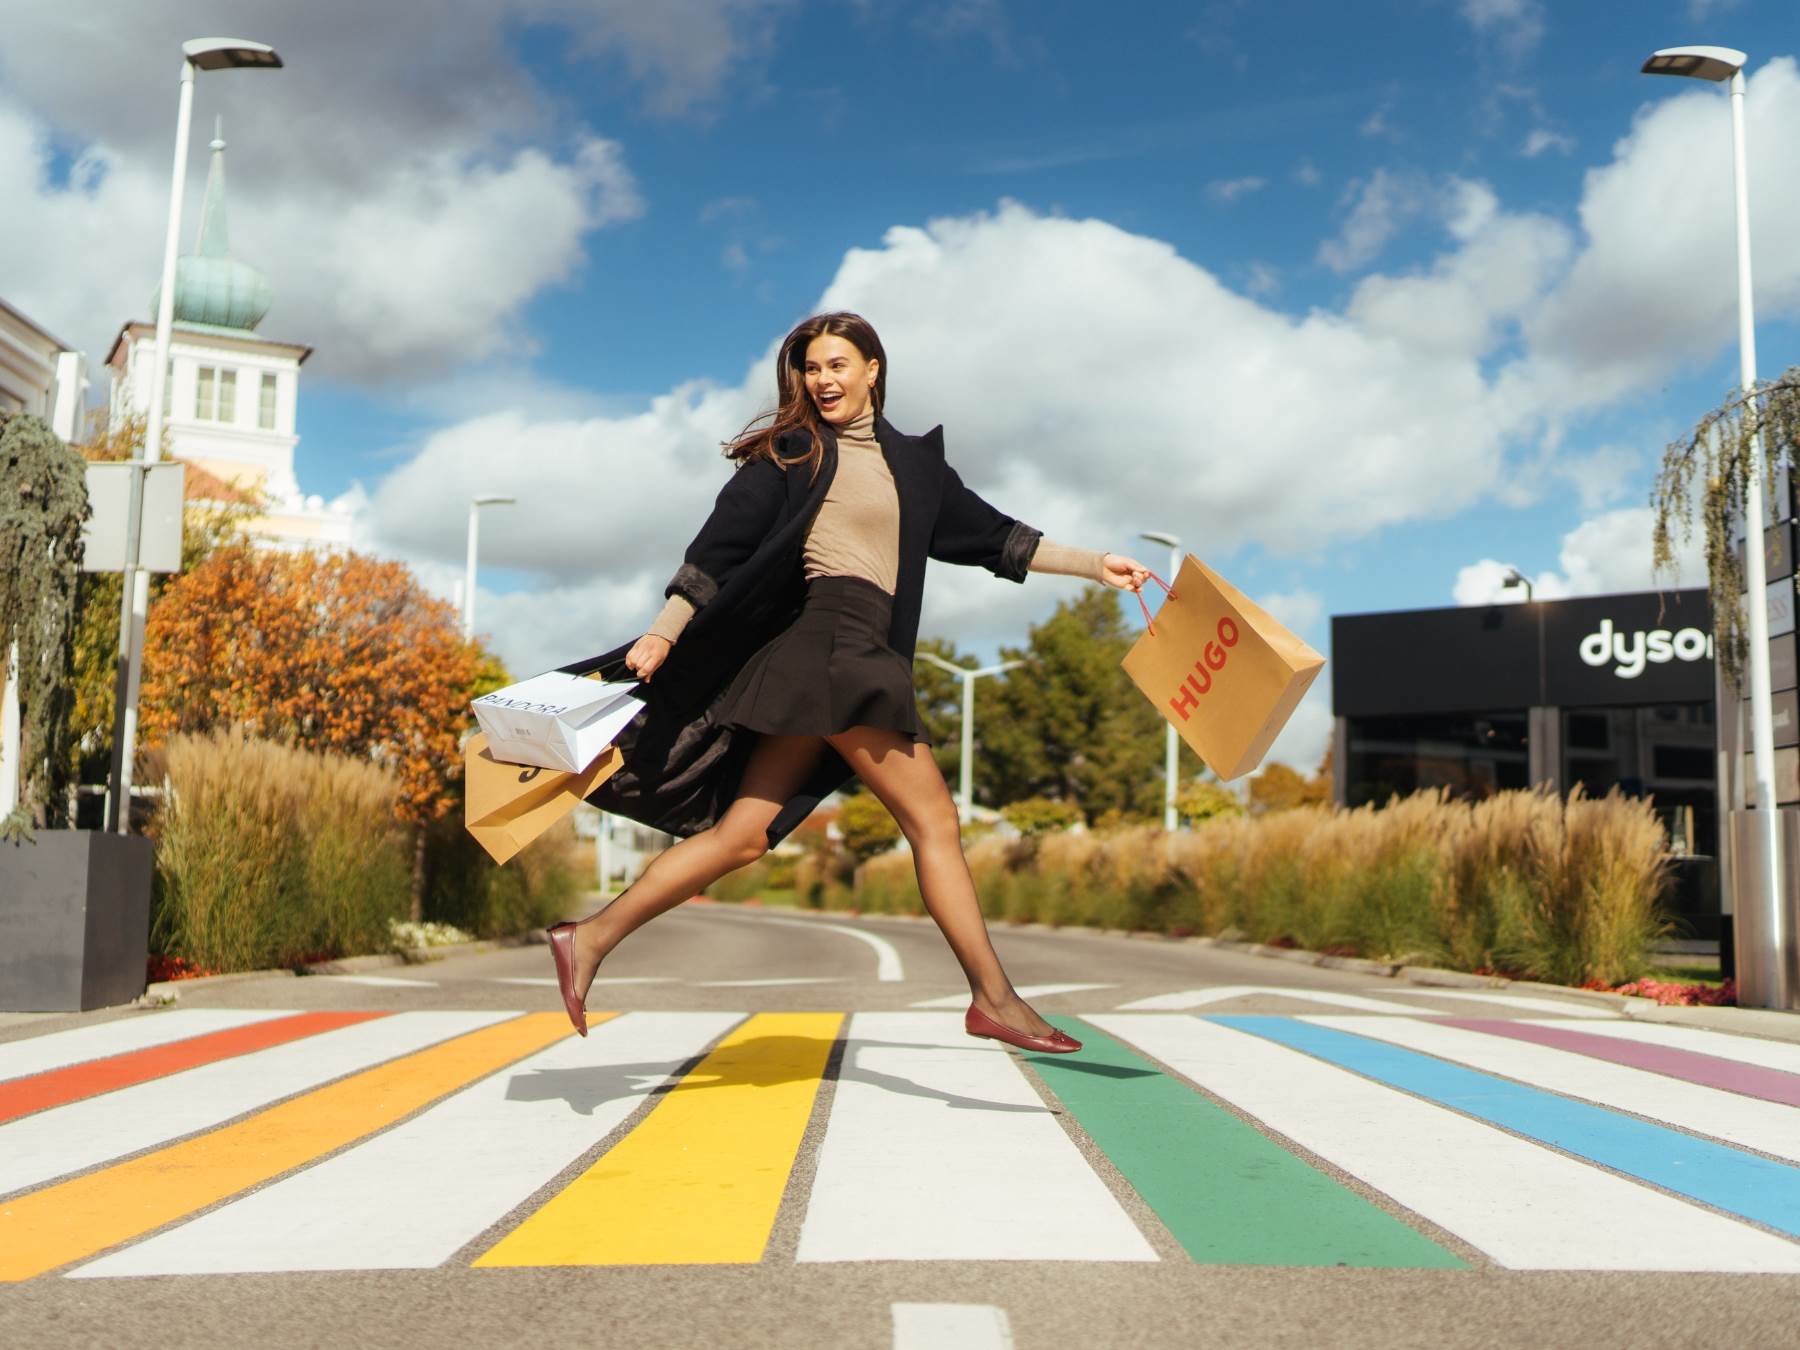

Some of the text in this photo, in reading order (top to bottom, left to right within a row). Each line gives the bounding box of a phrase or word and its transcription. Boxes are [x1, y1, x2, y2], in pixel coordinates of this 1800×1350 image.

[1169, 616, 1239, 722] HUGO
[1579, 619, 1714, 679] dyso
[480, 694, 567, 714] PANDORA
